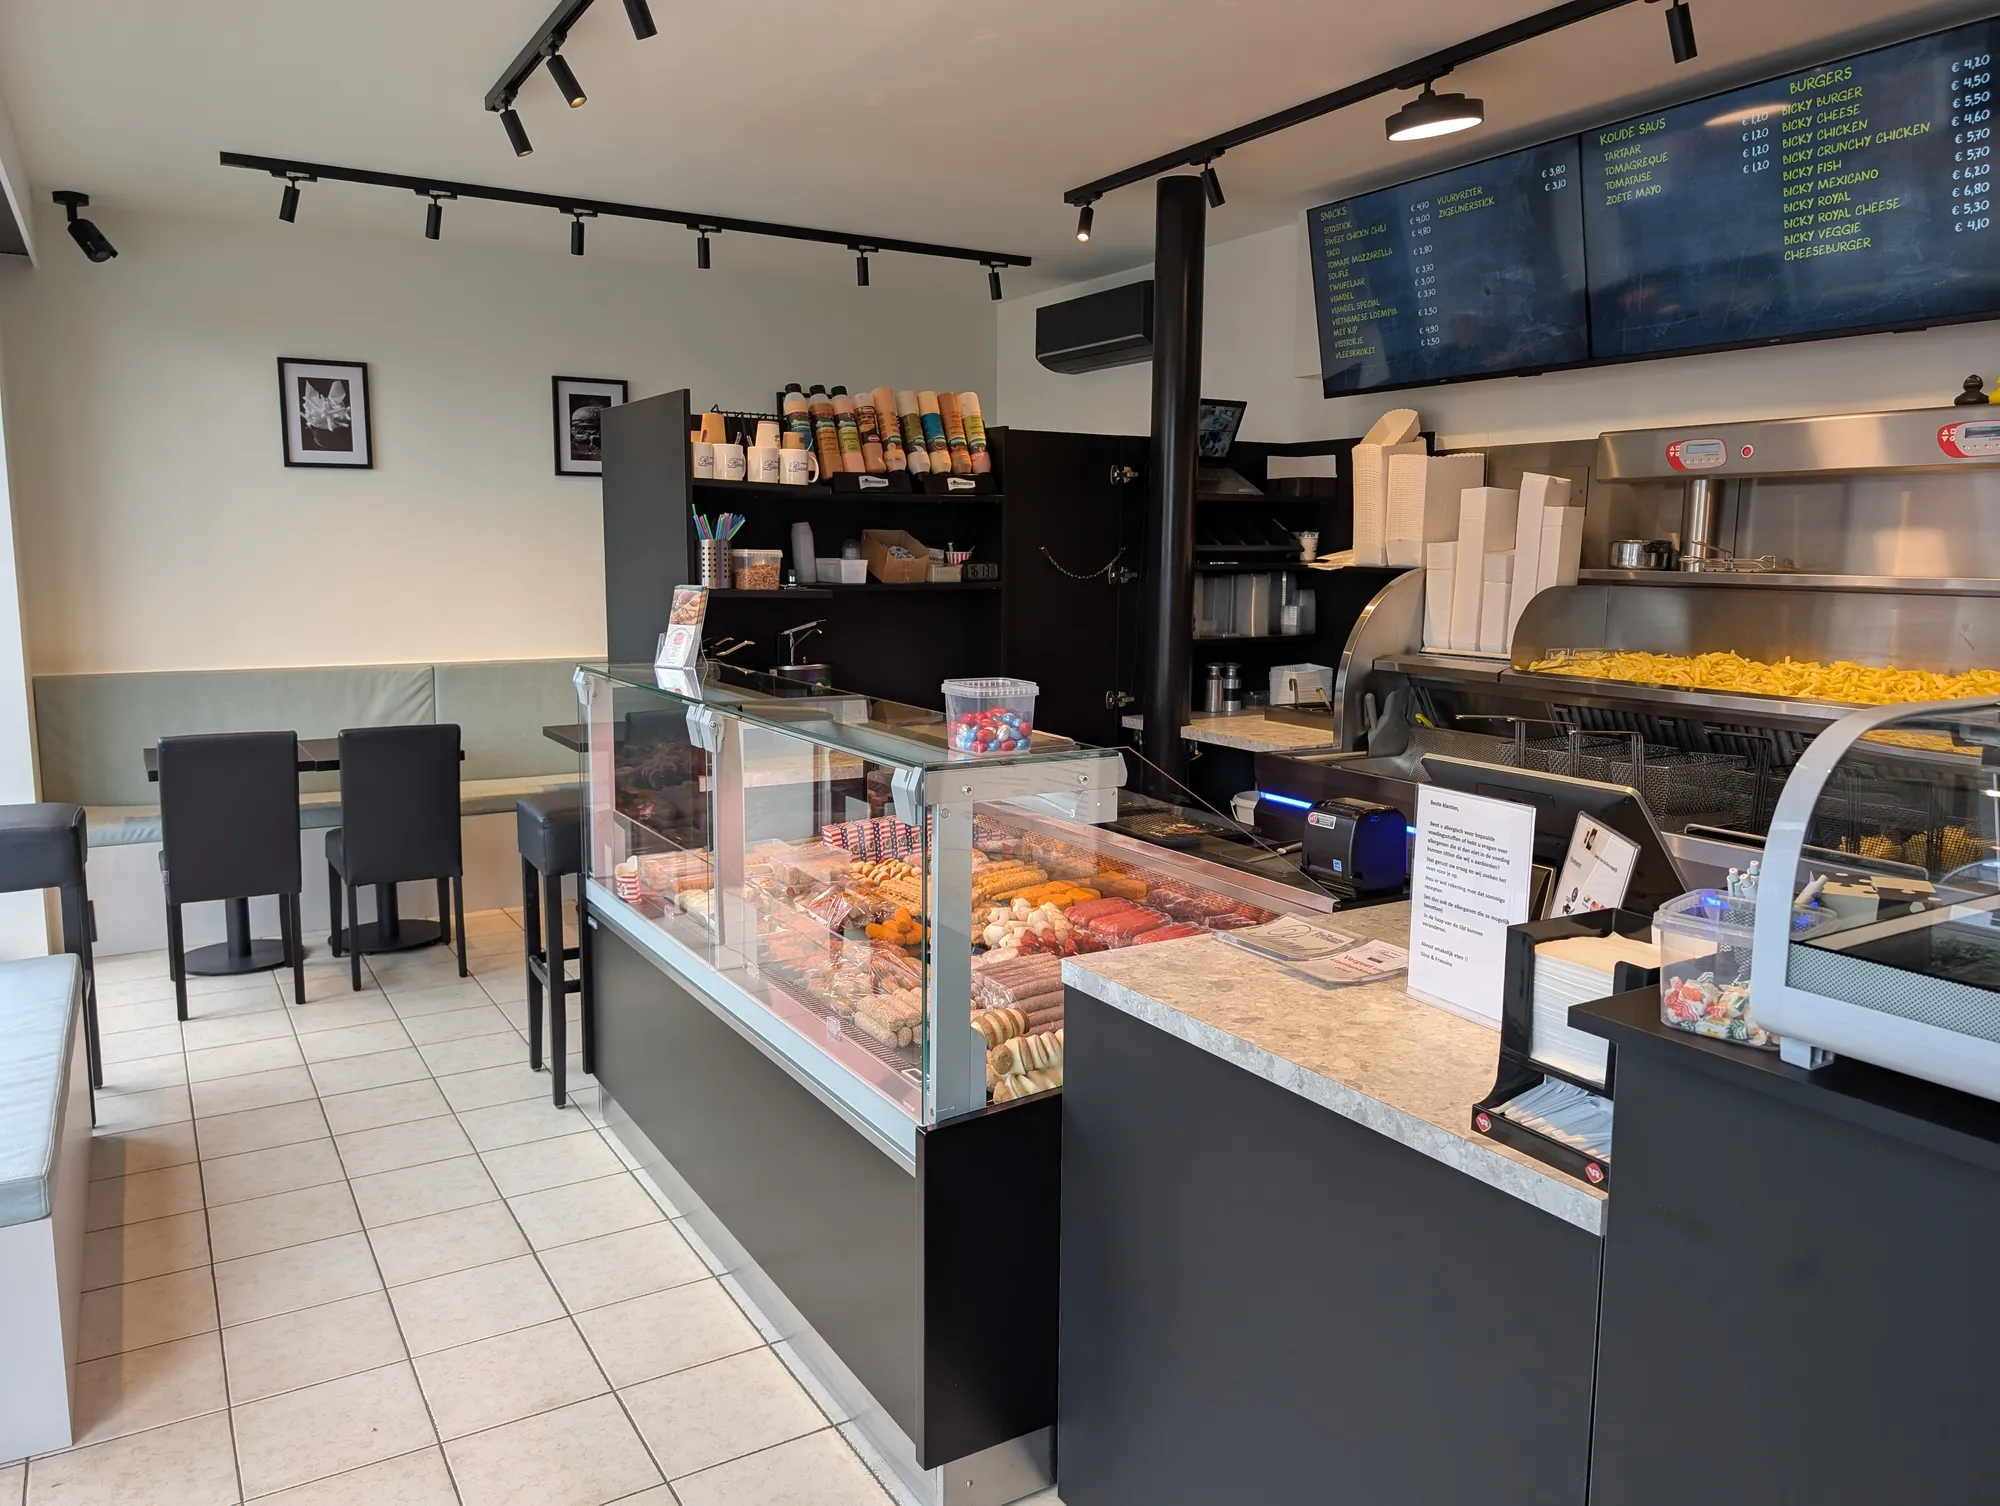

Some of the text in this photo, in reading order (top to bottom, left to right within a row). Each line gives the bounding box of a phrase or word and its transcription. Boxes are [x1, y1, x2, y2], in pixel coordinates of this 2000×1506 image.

[1952, 55, 1990, 72] € 4,20
[1790, 67, 1852, 94] BURGERS
[1951, 73, 1990, 90] € 4,50
[1781, 86, 1863, 116] BICKY BURGER
[1953, 91, 1990, 108] € 5,50
[1742, 112, 1769, 126] € 1,20
[1782, 104, 1860, 132] BICKY CHEESE
[1952, 109, 1990, 126] € 4,60
[1600, 118, 1666, 146] KOUDE SAUS
[1742, 128, 1769, 142] € 1,20
[1782, 119, 1868, 149] BICKY CHICKEN
[1955, 128, 1990, 144] € 5,70
[1743, 144, 1769, 158] € 1,20
[1782, 122, 1931, 165] BICKY CRUNCHY CHICKEN
[1604, 144, 1641, 162] TARTAAR
[1955, 146, 1990, 161] € 5,70
[1542, 165, 1566, 178] € 3,80
[1605, 152, 1668, 176] TOMAGREQUE
[1743, 160, 1770, 173] € 1,20
[1783, 160, 1842, 181] BICKY FISH
[1952, 164, 1990, 180] € 6,20
[1545, 179, 1566, 191] € 3,10
[1605, 171, 1652, 191] TOMATAISE
[1783, 169, 1879, 197] BICKY MEXICANO
[1436, 186, 1483, 205] VUURVRETER
[1606, 185, 1662, 205] ZOETE MAYO
[1952, 182, 1989, 197] € 6,80
[1417, 201, 1429, 210] 4,70
[1438, 197, 1495, 218] ZIGEUNERSTICK
[1784, 191, 1851, 213] BICKY ROYAL
[1952, 200, 1989, 215] € 5,30
[1321, 207, 1347, 221] SNACKS
[1416, 214, 1430, 223] 4,00
[1784, 198, 1900, 229] BICKY ROYAL CHEESE
[1418, 226, 1431, 235] 4,80
[1955, 218, 1989, 232] € 4,10
[1325, 236, 1344, 246] SWEET
[1371, 224, 1387, 235] CHILI
[1784, 222, 1862, 245] BICKY VEGGIE
[1326, 248, 1340, 257] TACO
[1419, 245, 1433, 254] 2,80
[1784, 237, 1871, 261] CHEESEBURGER
[1327, 248, 1393, 269] TOMAAT MOZZARELLA
[1422, 264, 1434, 272] 3,70
[1329, 278, 1365, 291] TWIJFELAAR
[1421, 276, 1435, 285] 3,00
[1330, 292, 1354, 303] VIANDEL
[1424, 288, 1436, 298] 3,70
[1331, 299, 1380, 314] VIANDEL SPECIAL
[1424, 307, 1437, 316] 2,50
[1332, 308, 1397, 326] VIETNAMESE LOEMPIA
[1333, 329, 1345, 337] MET
[1425, 325, 1439, 333] 4,90
[1427, 337, 1440, 346] 2,50
[1335, 347, 1375, 359] VLEESKROKET
[1442, 802, 1459, 812] klanten,
[1444, 825, 1463, 834] allergisch
[1475, 832, 1495, 842] bepaalde
[1427, 846, 1442, 854] kunnen
[1475, 860, 1500, 870] aanbieden?
[1428, 838, 1449, 847] allergenen
[1492, 856, 1510, 865] voeding
